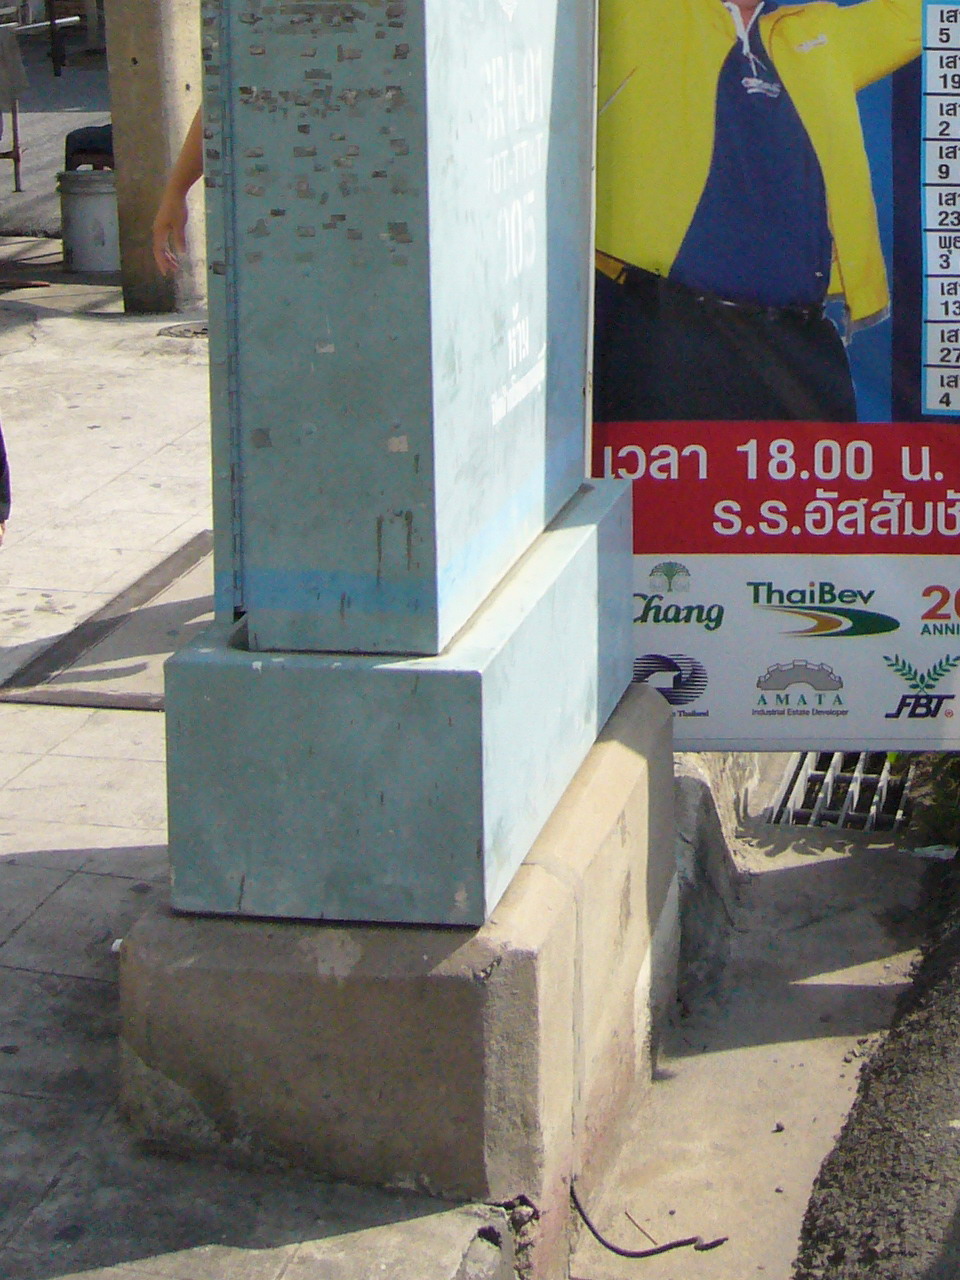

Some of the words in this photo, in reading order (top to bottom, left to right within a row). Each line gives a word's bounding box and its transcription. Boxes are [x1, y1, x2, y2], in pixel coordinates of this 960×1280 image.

[938, 29, 951, 44] 5
[938, 122, 951, 137] 2
[938, 164, 950, 179] 9
[939, 255, 951, 269] 3
[939, 393, 951, 408] 4
[603, 444, 708, 480] เวลา
[737, 438, 873, 481] 18.00
[901, 446, 944, 481] น.
[746, 581, 876, 605] ThaiBev
[757, 693, 843, 706] AMATA
[884, 693, 956, 719] FBT
[677, 709, 709, 717] Thailand
[751, 708, 785, 716] Industrial
[787, 708, 810, 716] Estate
[812, 708, 849, 717] Developer
